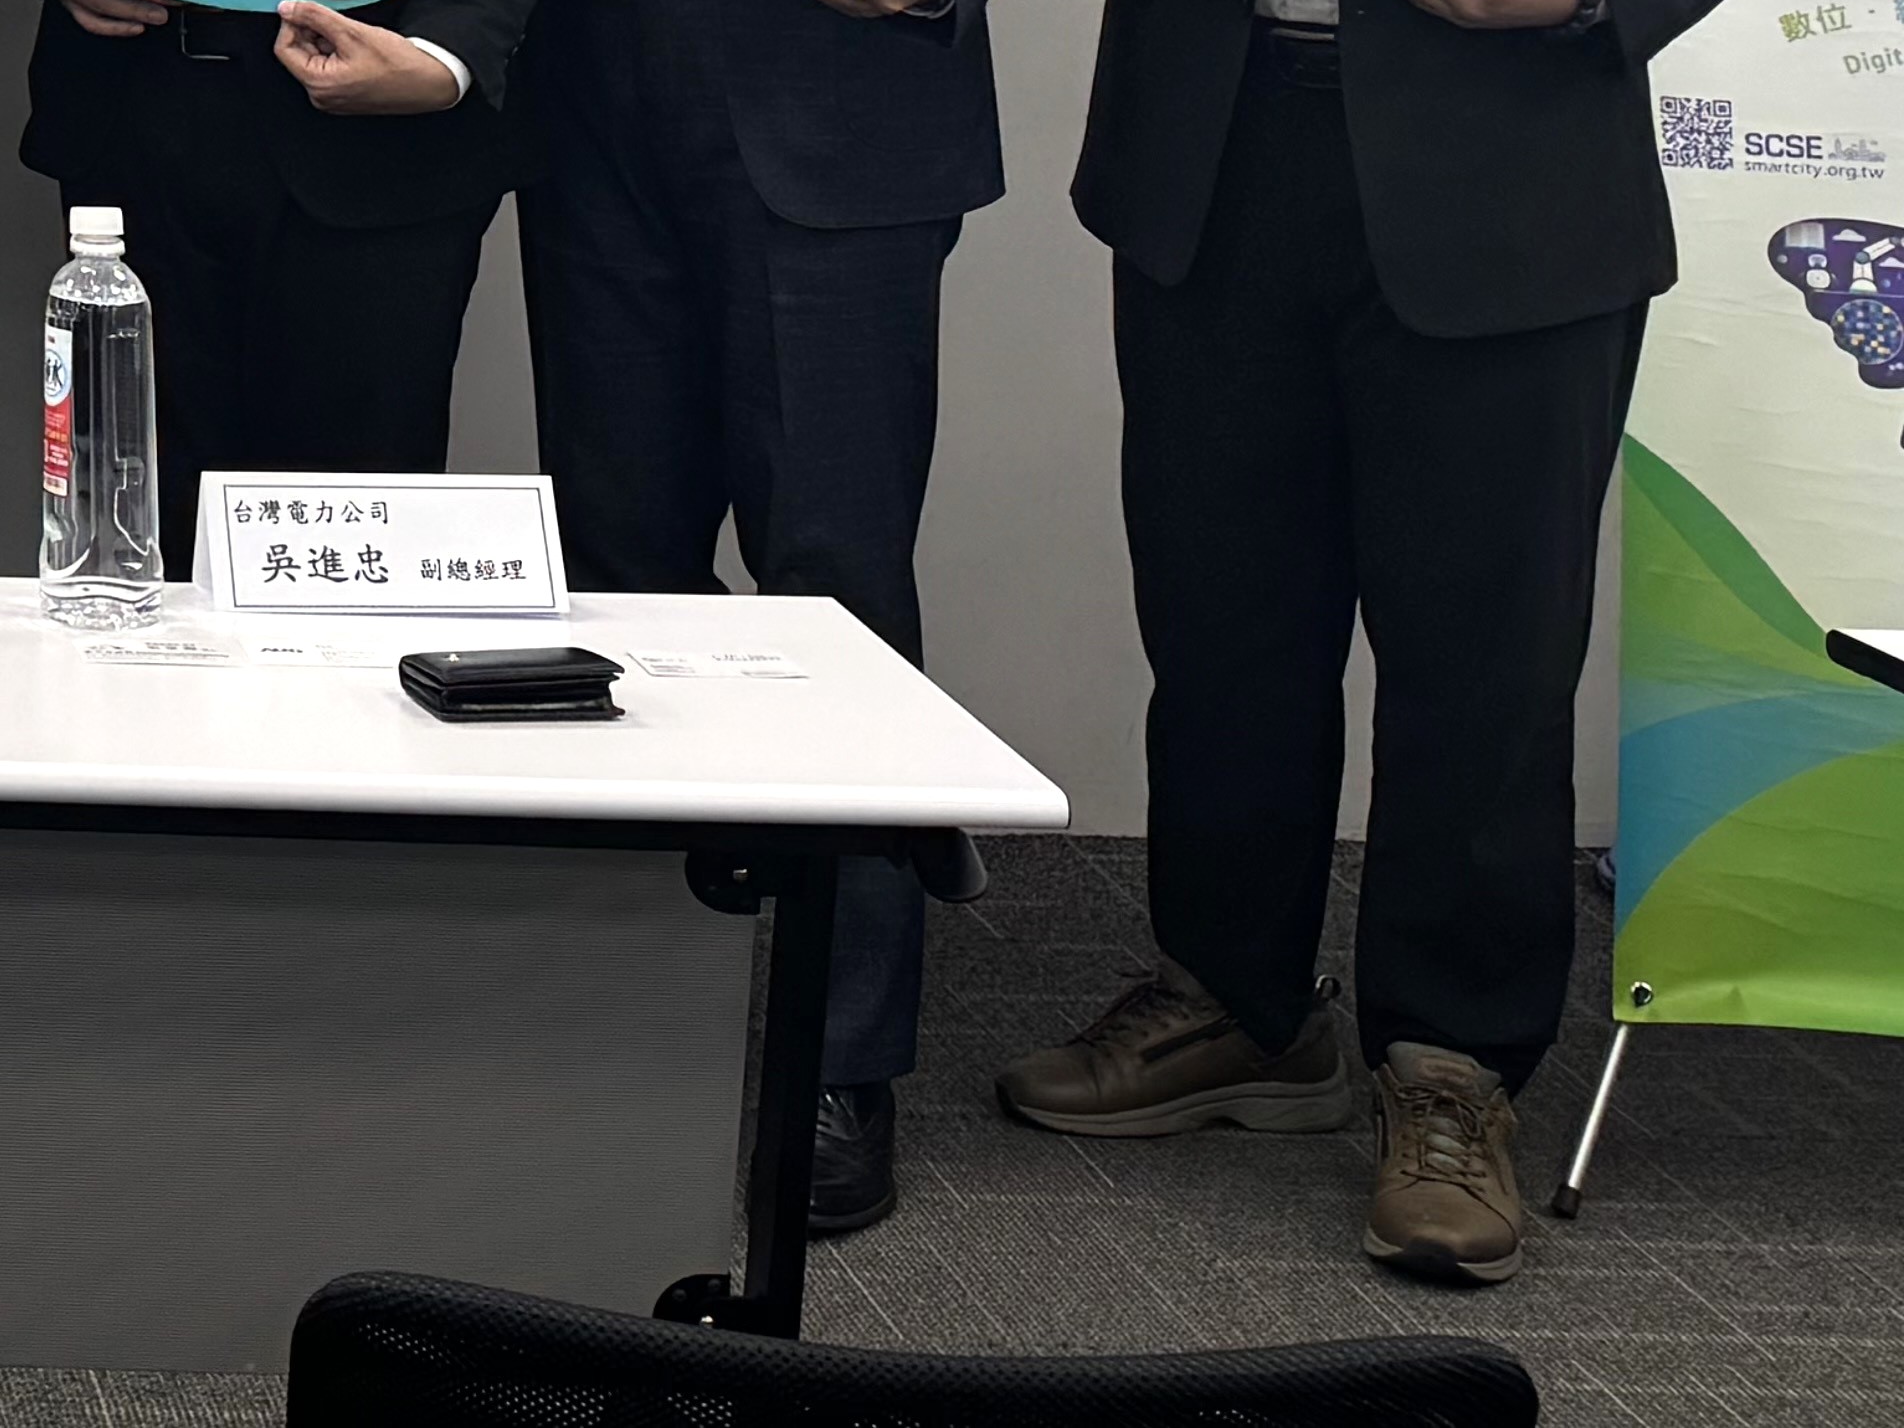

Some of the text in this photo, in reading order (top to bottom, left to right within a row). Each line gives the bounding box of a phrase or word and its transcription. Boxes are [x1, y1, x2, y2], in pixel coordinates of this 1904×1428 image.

[1744, 132, 1823, 160] SCSE
[1744, 160, 1885, 181] smartcity.org.tw
[234, 499, 389, 526] 台灣電力公司
[262, 544, 527, 584] 吳進忠 副總經理
